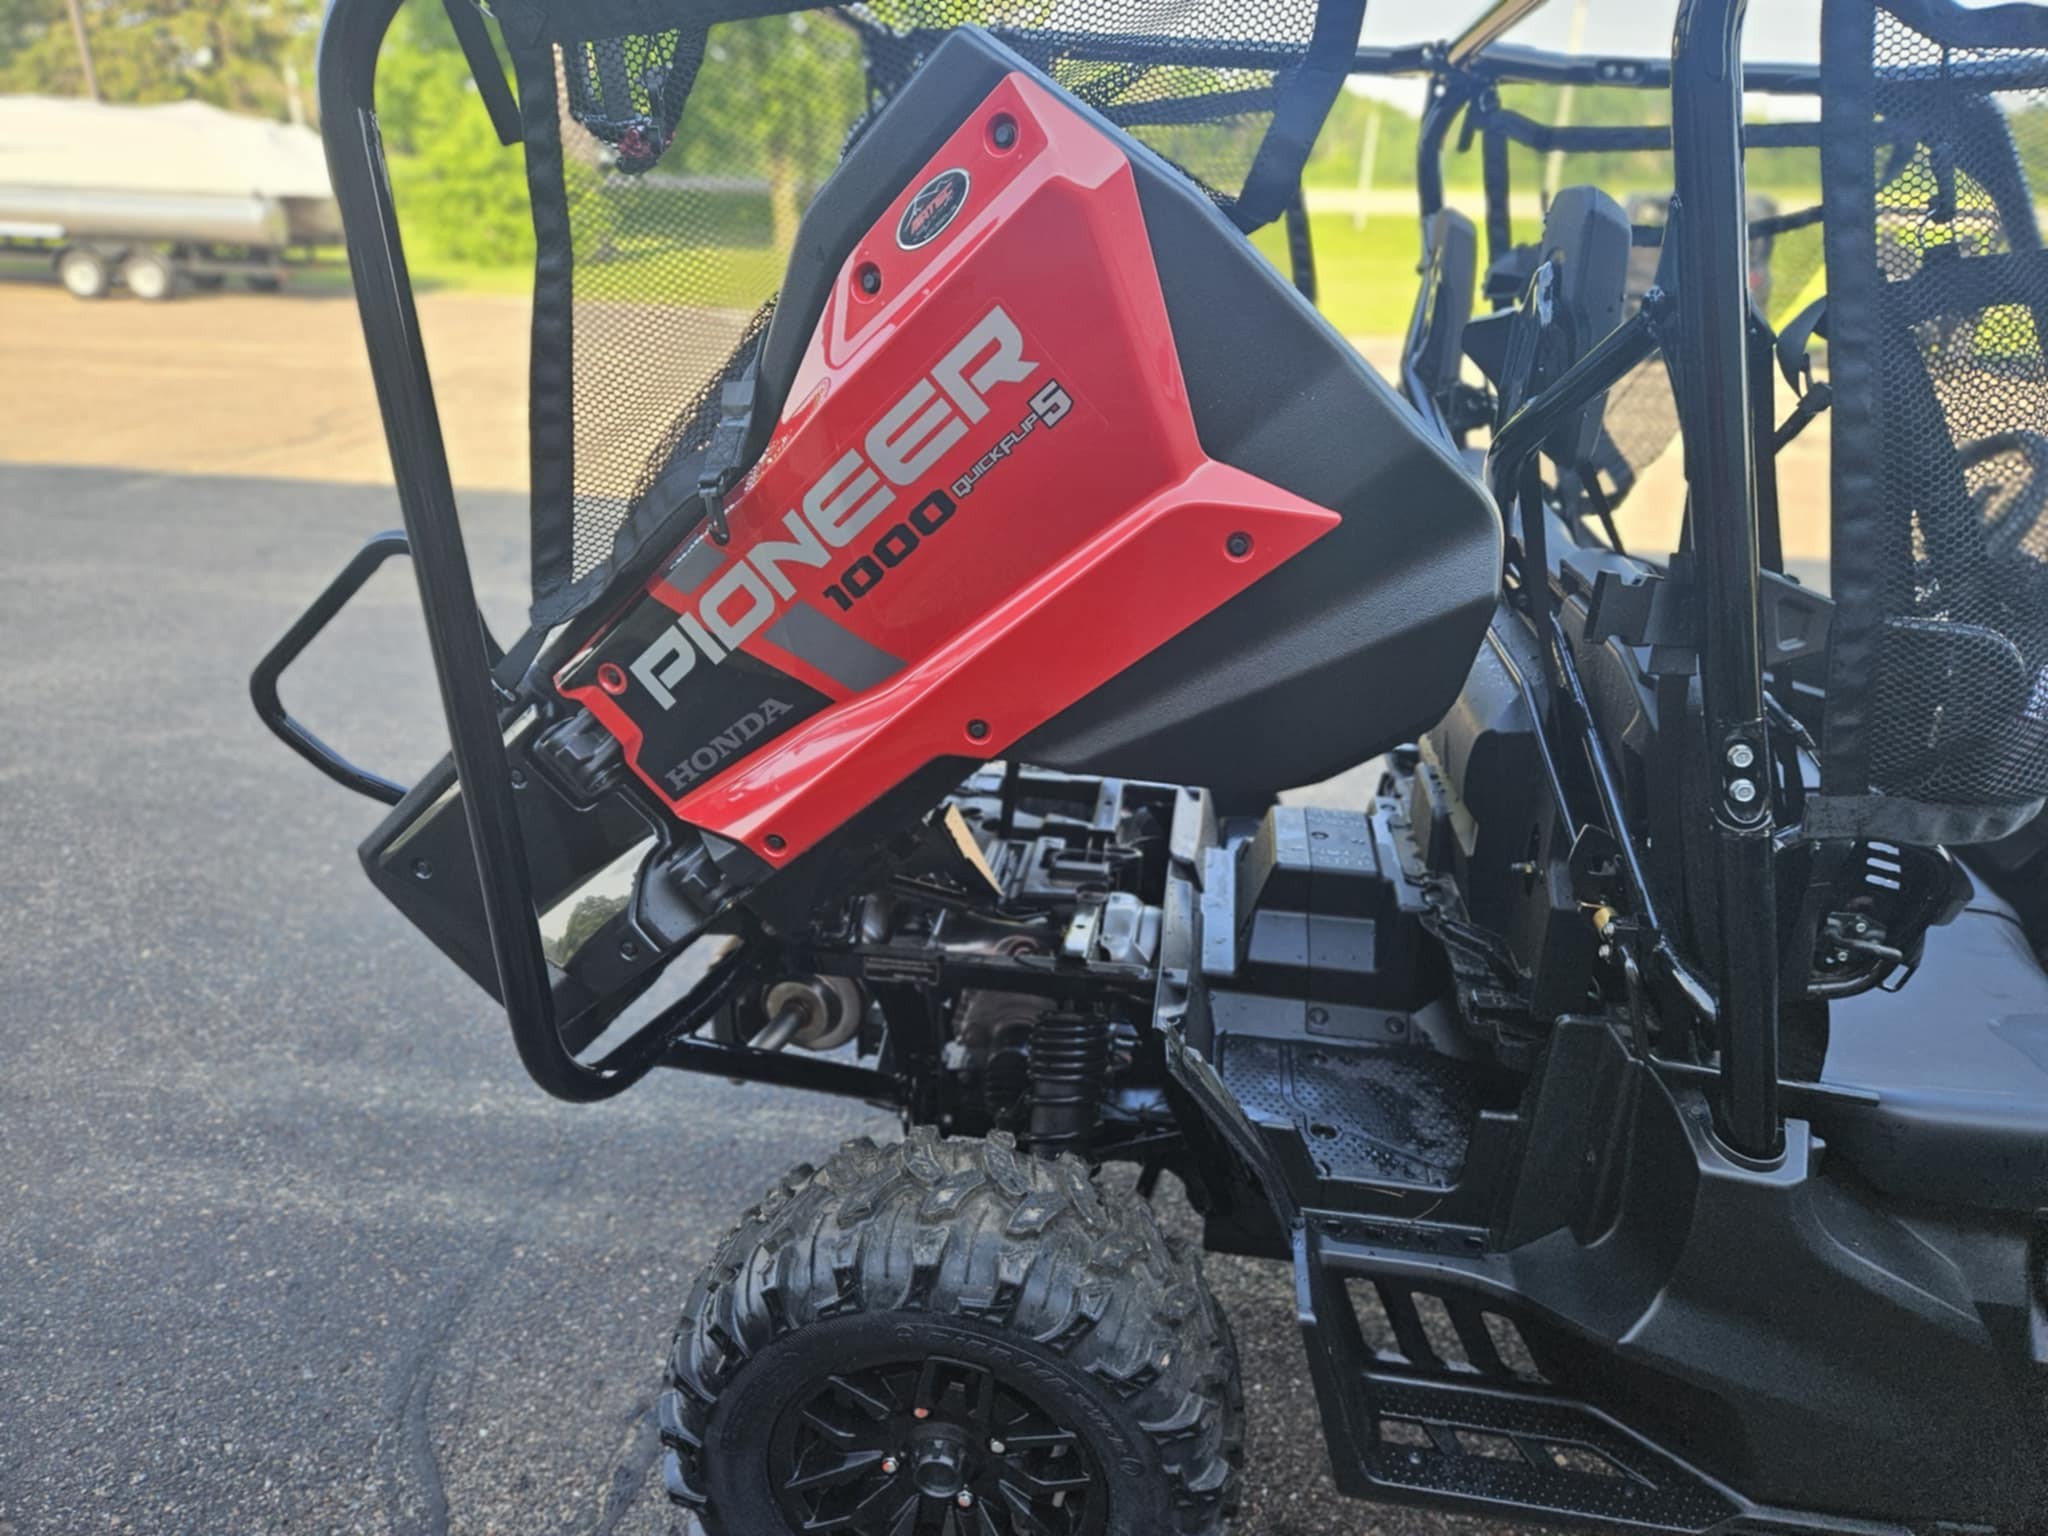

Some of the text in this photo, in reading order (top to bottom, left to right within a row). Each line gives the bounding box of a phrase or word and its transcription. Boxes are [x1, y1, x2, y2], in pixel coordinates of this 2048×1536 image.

[629, 304, 1040, 711] PIONEER
[822, 488, 957, 612] 1000
[664, 697, 794, 791] HONDA
